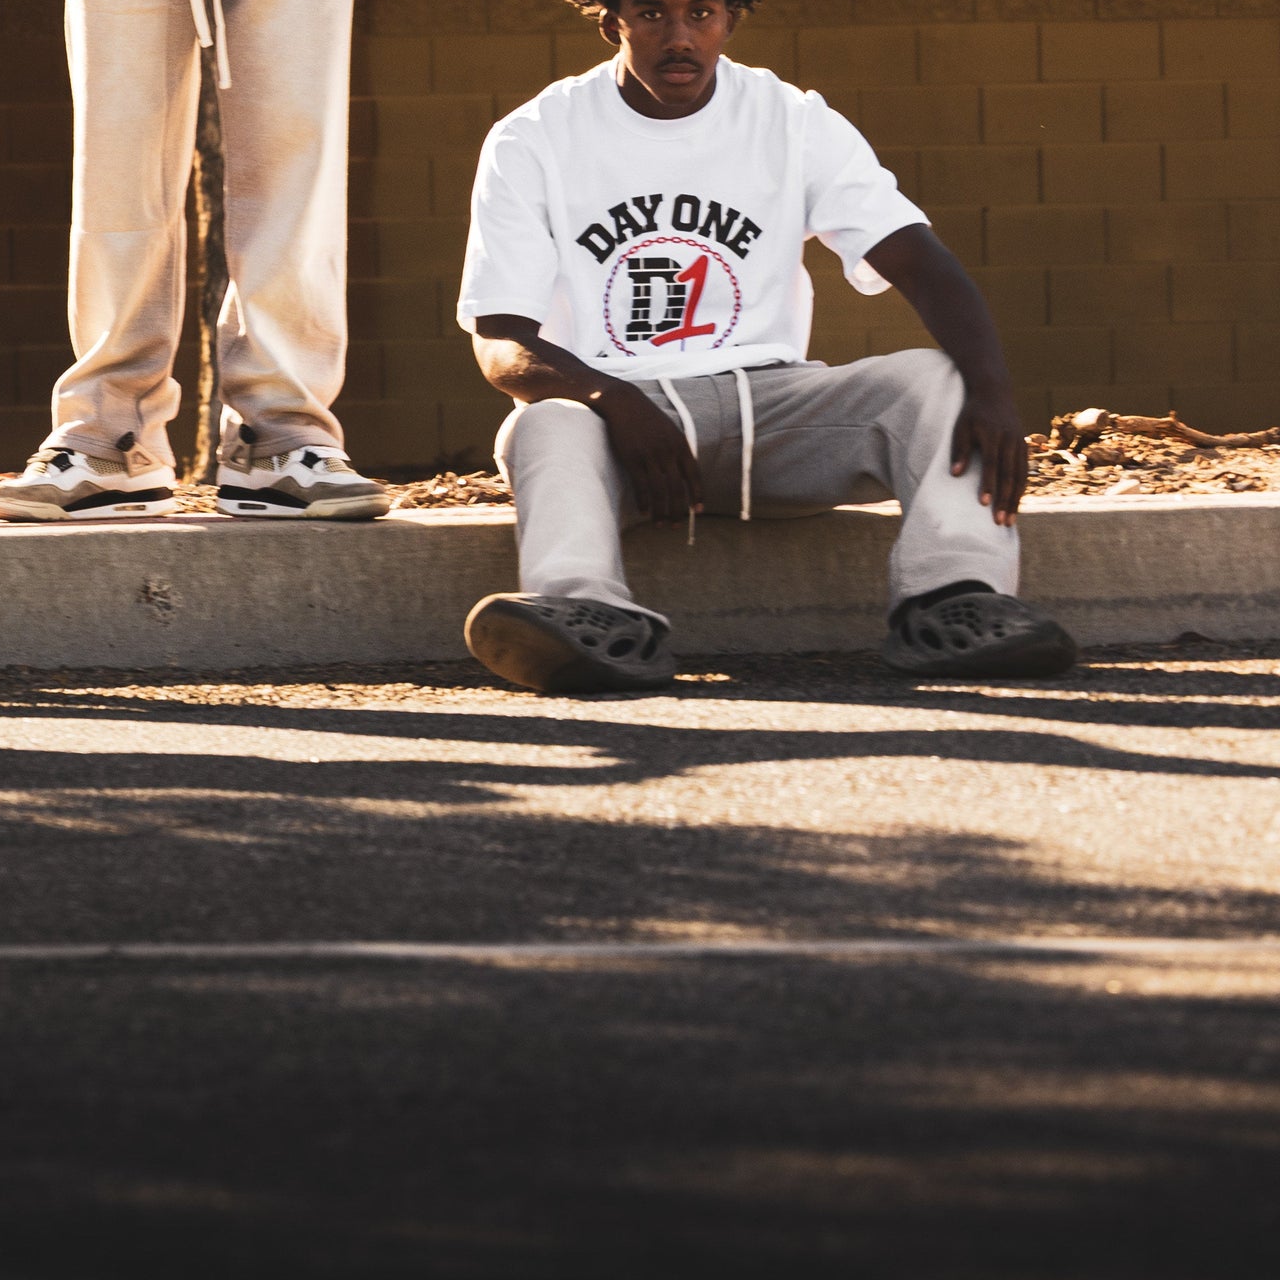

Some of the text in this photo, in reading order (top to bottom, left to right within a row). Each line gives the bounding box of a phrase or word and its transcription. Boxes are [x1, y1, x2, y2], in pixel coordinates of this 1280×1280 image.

[576, 194, 763, 264] DAY ONE
[626, 255, 716, 347] D1
